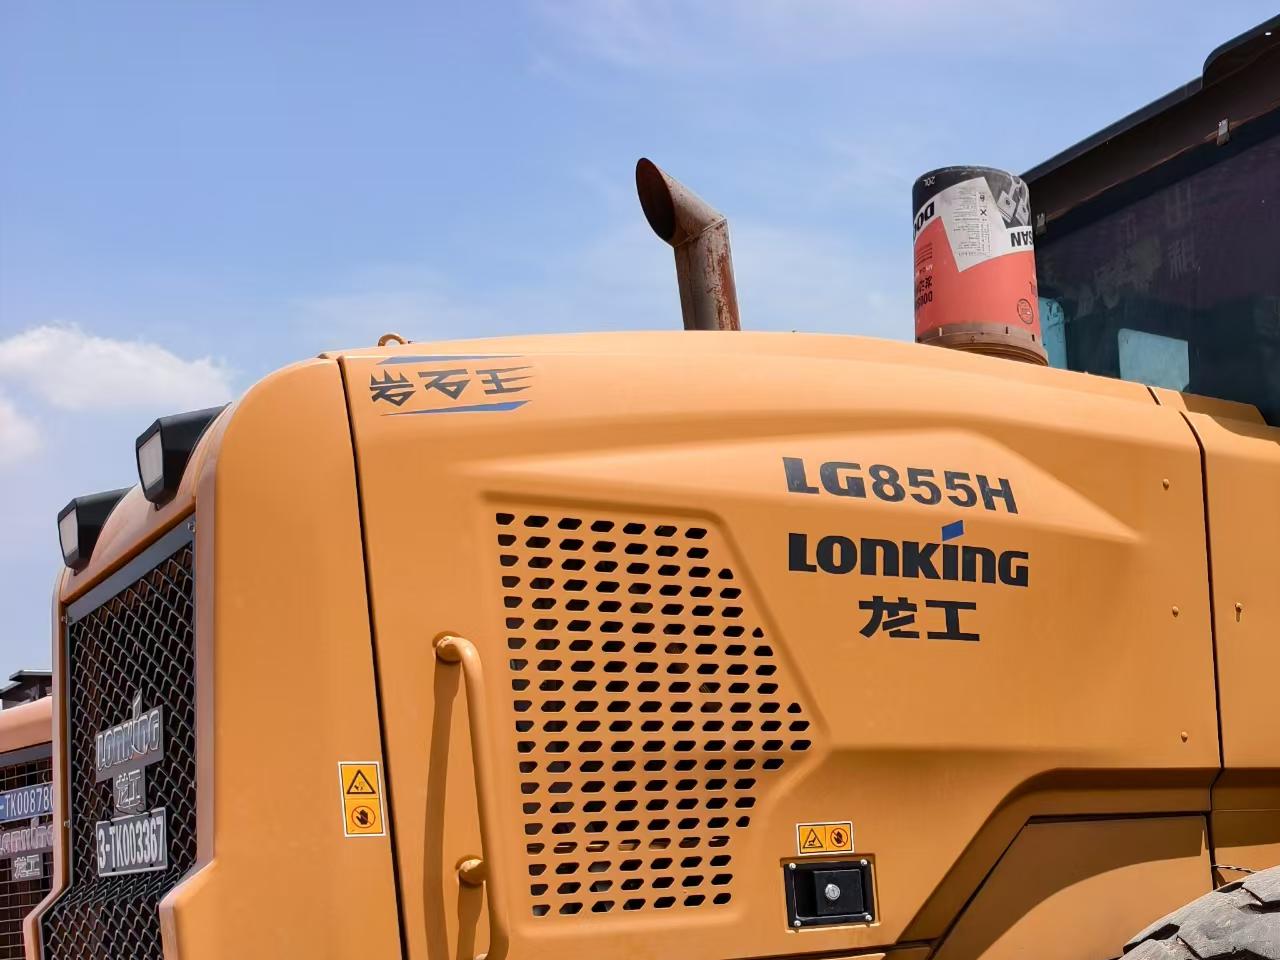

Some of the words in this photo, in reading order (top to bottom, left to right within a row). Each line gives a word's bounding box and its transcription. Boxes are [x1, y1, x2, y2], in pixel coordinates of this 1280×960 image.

[370, 365, 534, 407] 岩石王
[782, 456, 1018, 514] LG855H
[788, 520, 1029, 587] LONKING
[858, 595, 980, 642] 龙工
[115, 769, 142, 808] 龙工
[98, 816, 164, 868] 3-TK003367
[14, 854, 41, 879] 龙工
